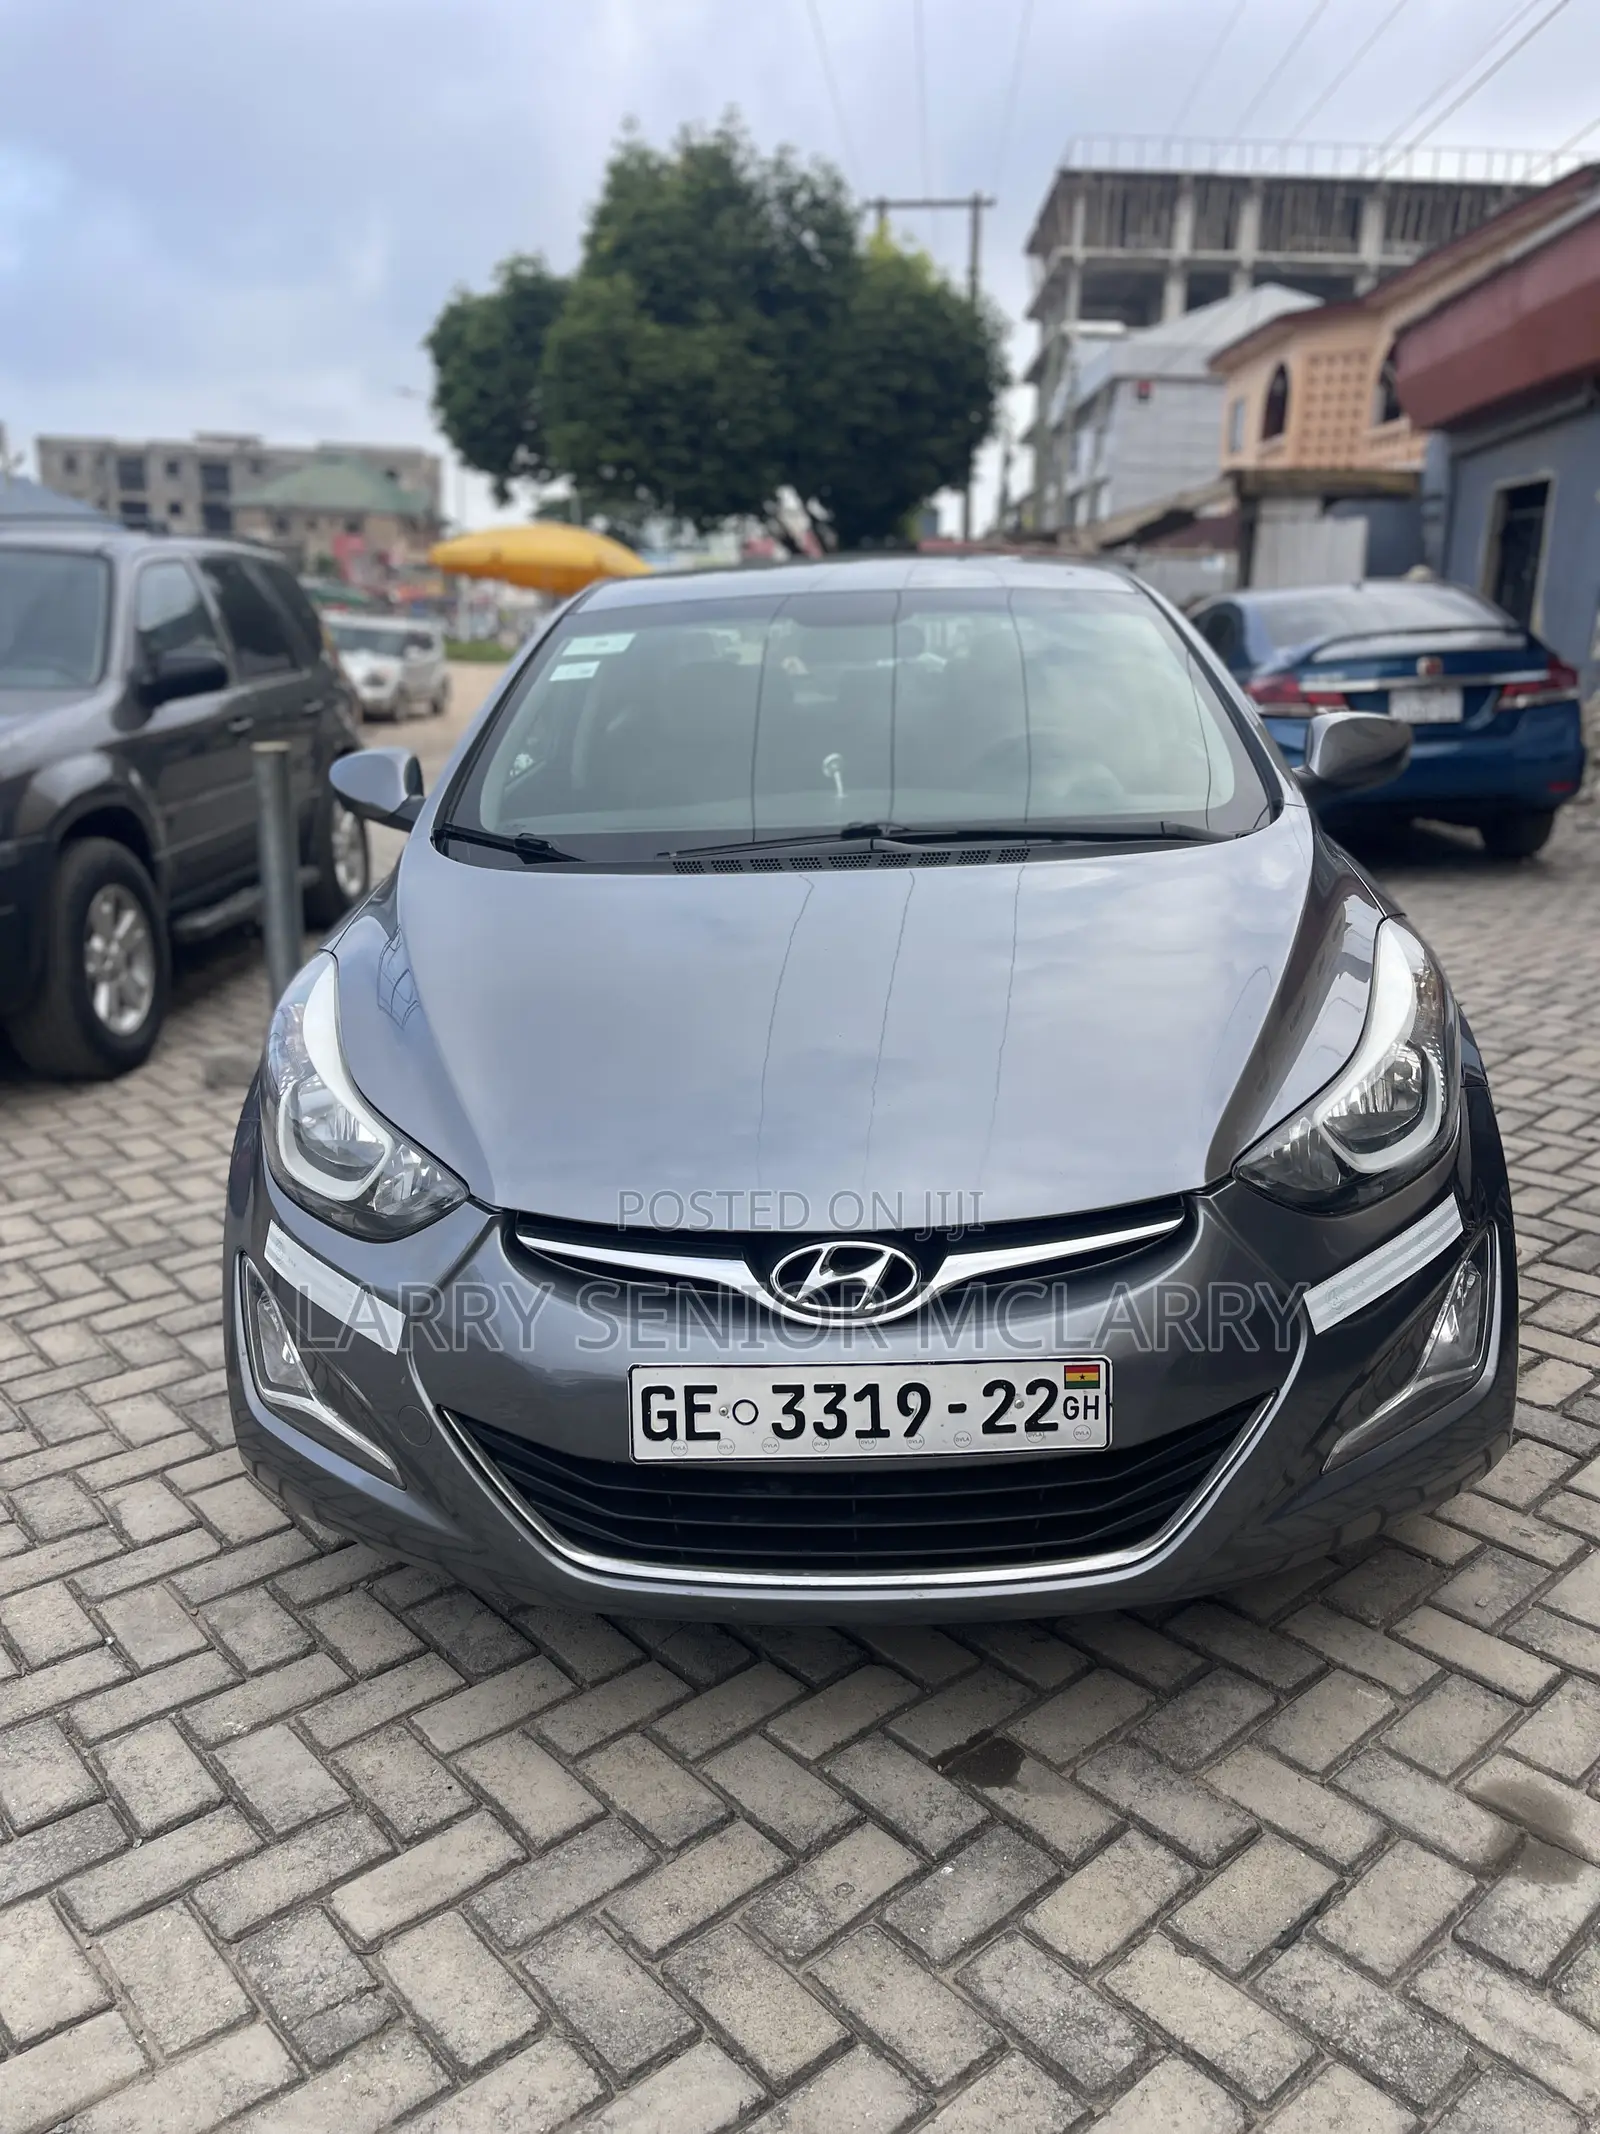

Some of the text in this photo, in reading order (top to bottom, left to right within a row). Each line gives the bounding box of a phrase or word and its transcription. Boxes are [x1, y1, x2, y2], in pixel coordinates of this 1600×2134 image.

[640, 1384, 722, 1441] GE
[770, 1382, 932, 1441] 3319
[981, 1378, 1059, 1435] 22
[1062, 1394, 1100, 1421] GH
